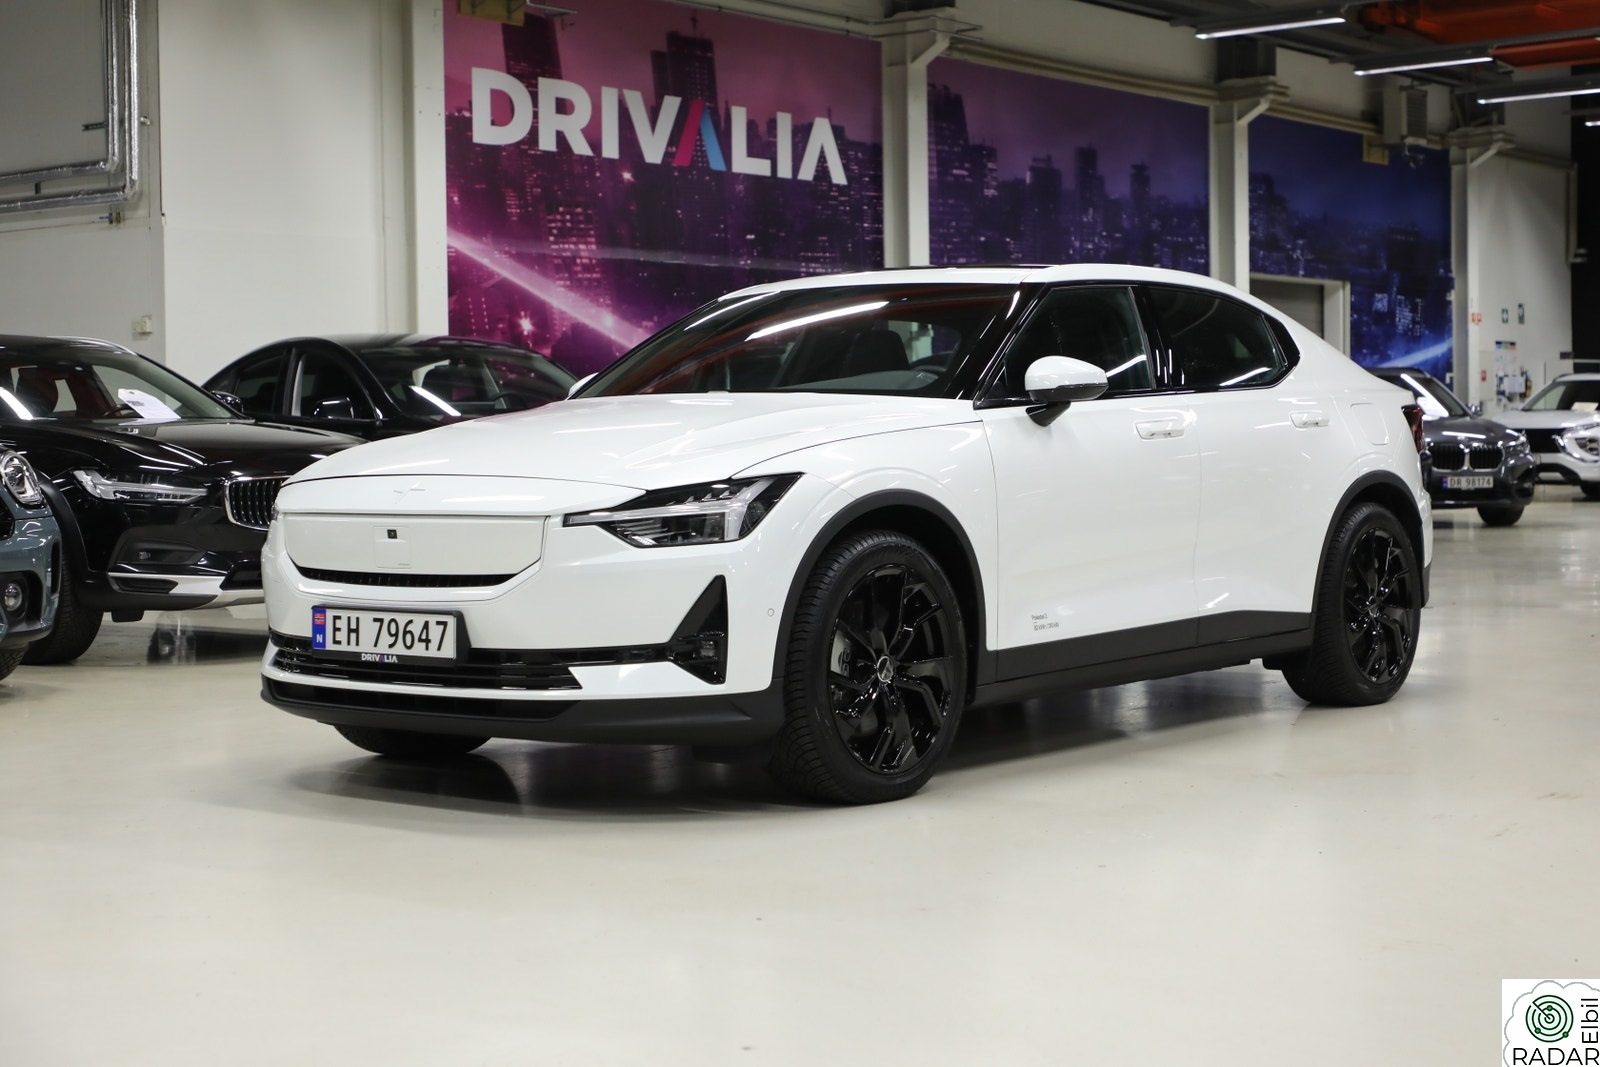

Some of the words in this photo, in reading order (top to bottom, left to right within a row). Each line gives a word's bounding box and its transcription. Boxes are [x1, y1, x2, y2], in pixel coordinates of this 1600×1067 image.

[471, 67, 848, 186] DRIVALIA
[1450, 478, 1461, 487] DR
[1465, 478, 1492, 487] 98174
[316, 634, 323, 643] N
[332, 615, 360, 647] EH
[372, 617, 449, 652] 79647
[361, 653, 398, 663] DRIVALIA
